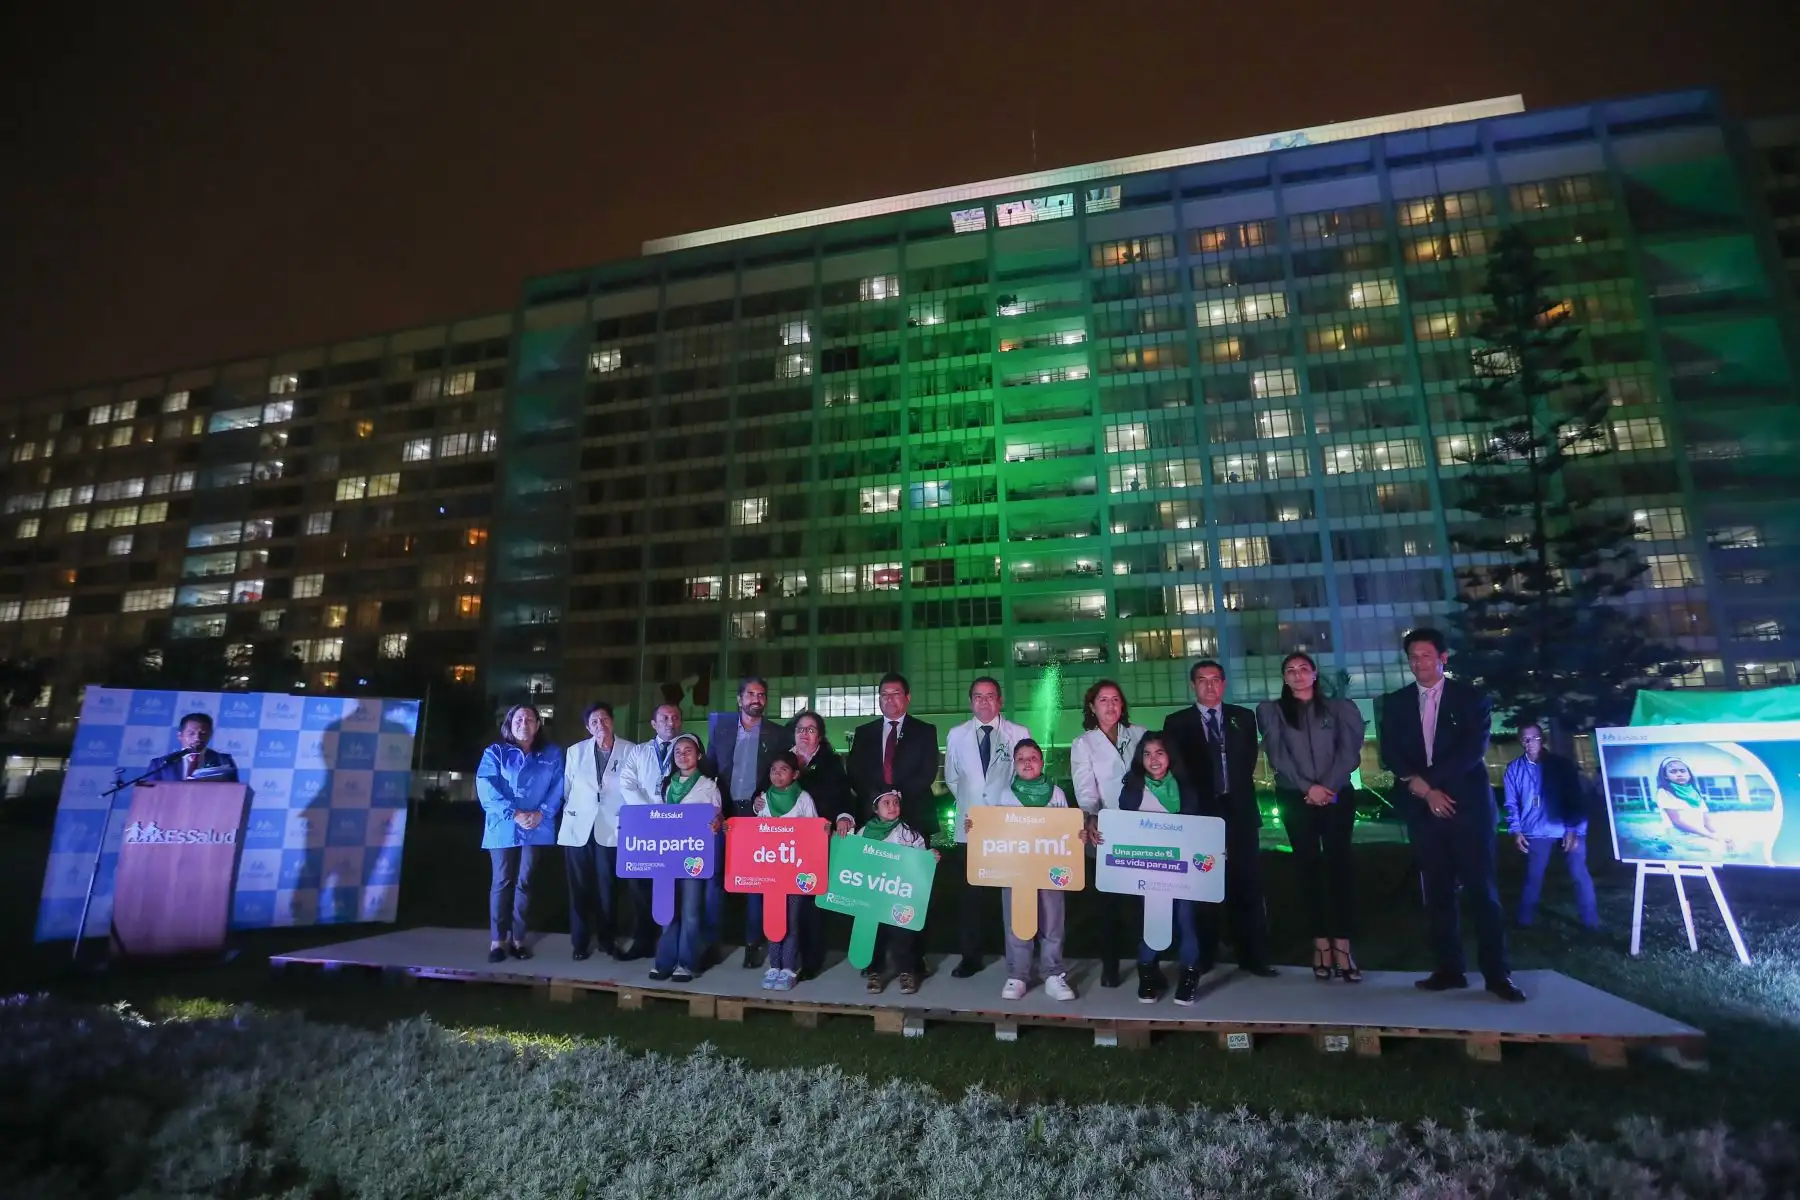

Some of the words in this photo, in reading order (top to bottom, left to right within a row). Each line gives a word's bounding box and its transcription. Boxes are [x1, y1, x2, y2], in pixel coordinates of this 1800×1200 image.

[1153, 822, 1183, 832] EsSalud
[165, 829, 239, 844] EsSalud
[982, 838, 1030, 857] para
[1034, 833, 1072, 856] mí.
[625, 836, 657, 851] Una
[659, 836, 705, 855] parte
[753, 846, 777, 863] de
[778, 840, 803, 868] ti,
[1131, 849, 1153, 857] parte
[1126, 858, 1146, 867] vida
[839, 869, 864, 887] es
[867, 871, 913, 899] vida
